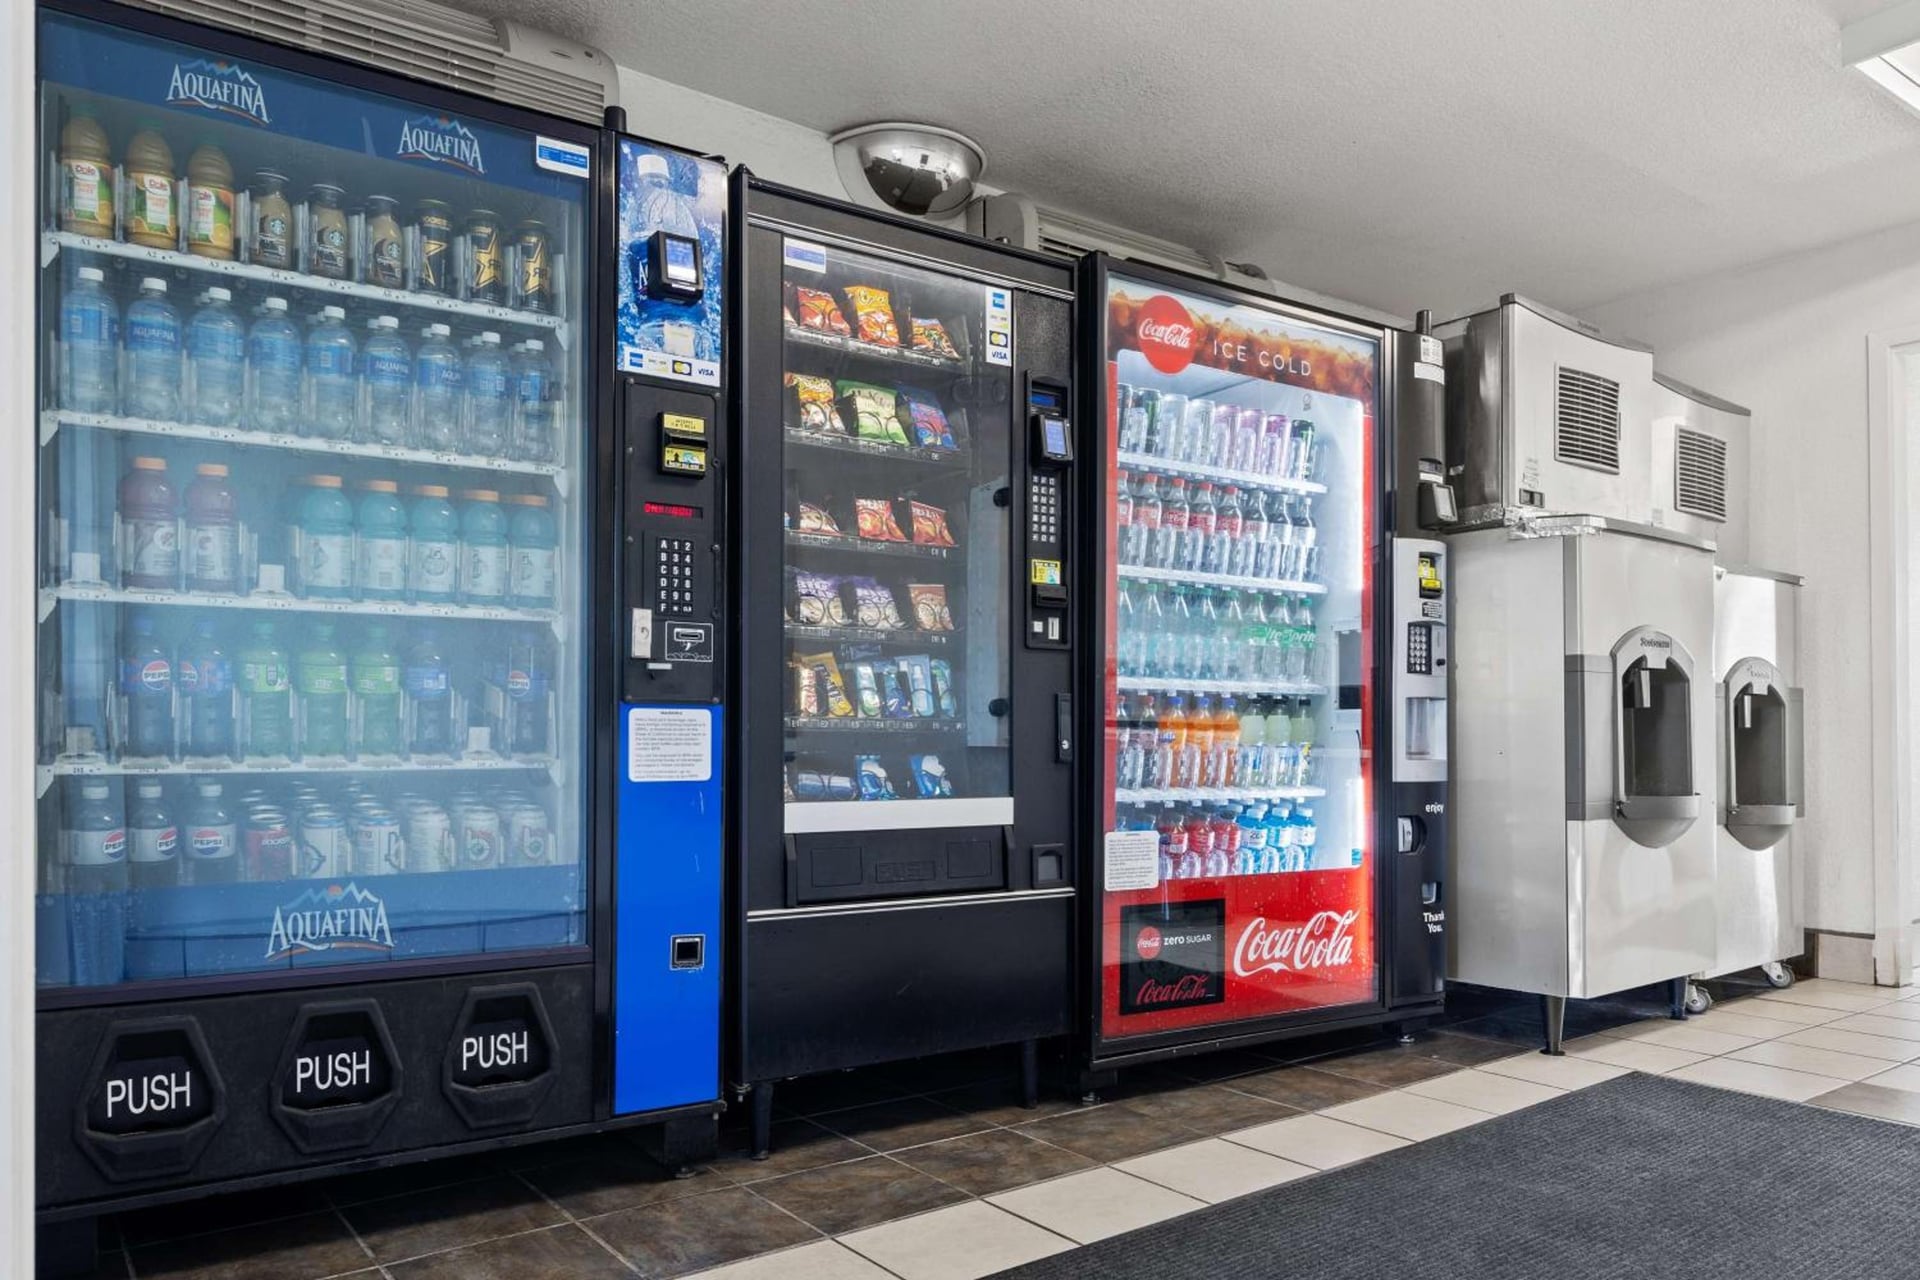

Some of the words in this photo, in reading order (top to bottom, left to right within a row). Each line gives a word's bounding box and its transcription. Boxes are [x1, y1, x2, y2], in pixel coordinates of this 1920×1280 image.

[166, 64, 270, 123] AQUAFINA
[397, 120, 486, 174] AQUAFINA
[75, 164, 96, 176] Dole
[149, 178, 168, 191] Dole
[991, 351, 1008, 360] VISA
[1213, 340, 1247, 362] ICE
[1259, 350, 1312, 377] COLD
[697, 368, 715, 377] VISA
[661, 540, 668, 549] A
[673, 541, 679, 549] 1
[685, 542, 691, 551] 2
[661, 552, 667, 561] B
[685, 554, 691, 563] 4
[661, 565, 667, 574] C
[661, 577, 667, 587] D
[673, 578, 679, 587] 7
[661, 590, 667, 600] E
[673, 591, 679, 600] 9
[661, 603, 667, 612] F
[194, 839, 224, 847] PEPSI
[265, 900, 395, 960] AQUAFINA
[1163, 935, 1185, 946] zero
[1186, 934, 1212, 944] SUGAR
[1232, 909, 1360, 978] Coca-Cola
[462, 1030, 528, 1072] PUSH
[296, 1050, 370, 1093] PUSH
[106, 1071, 191, 1118] PUSH
